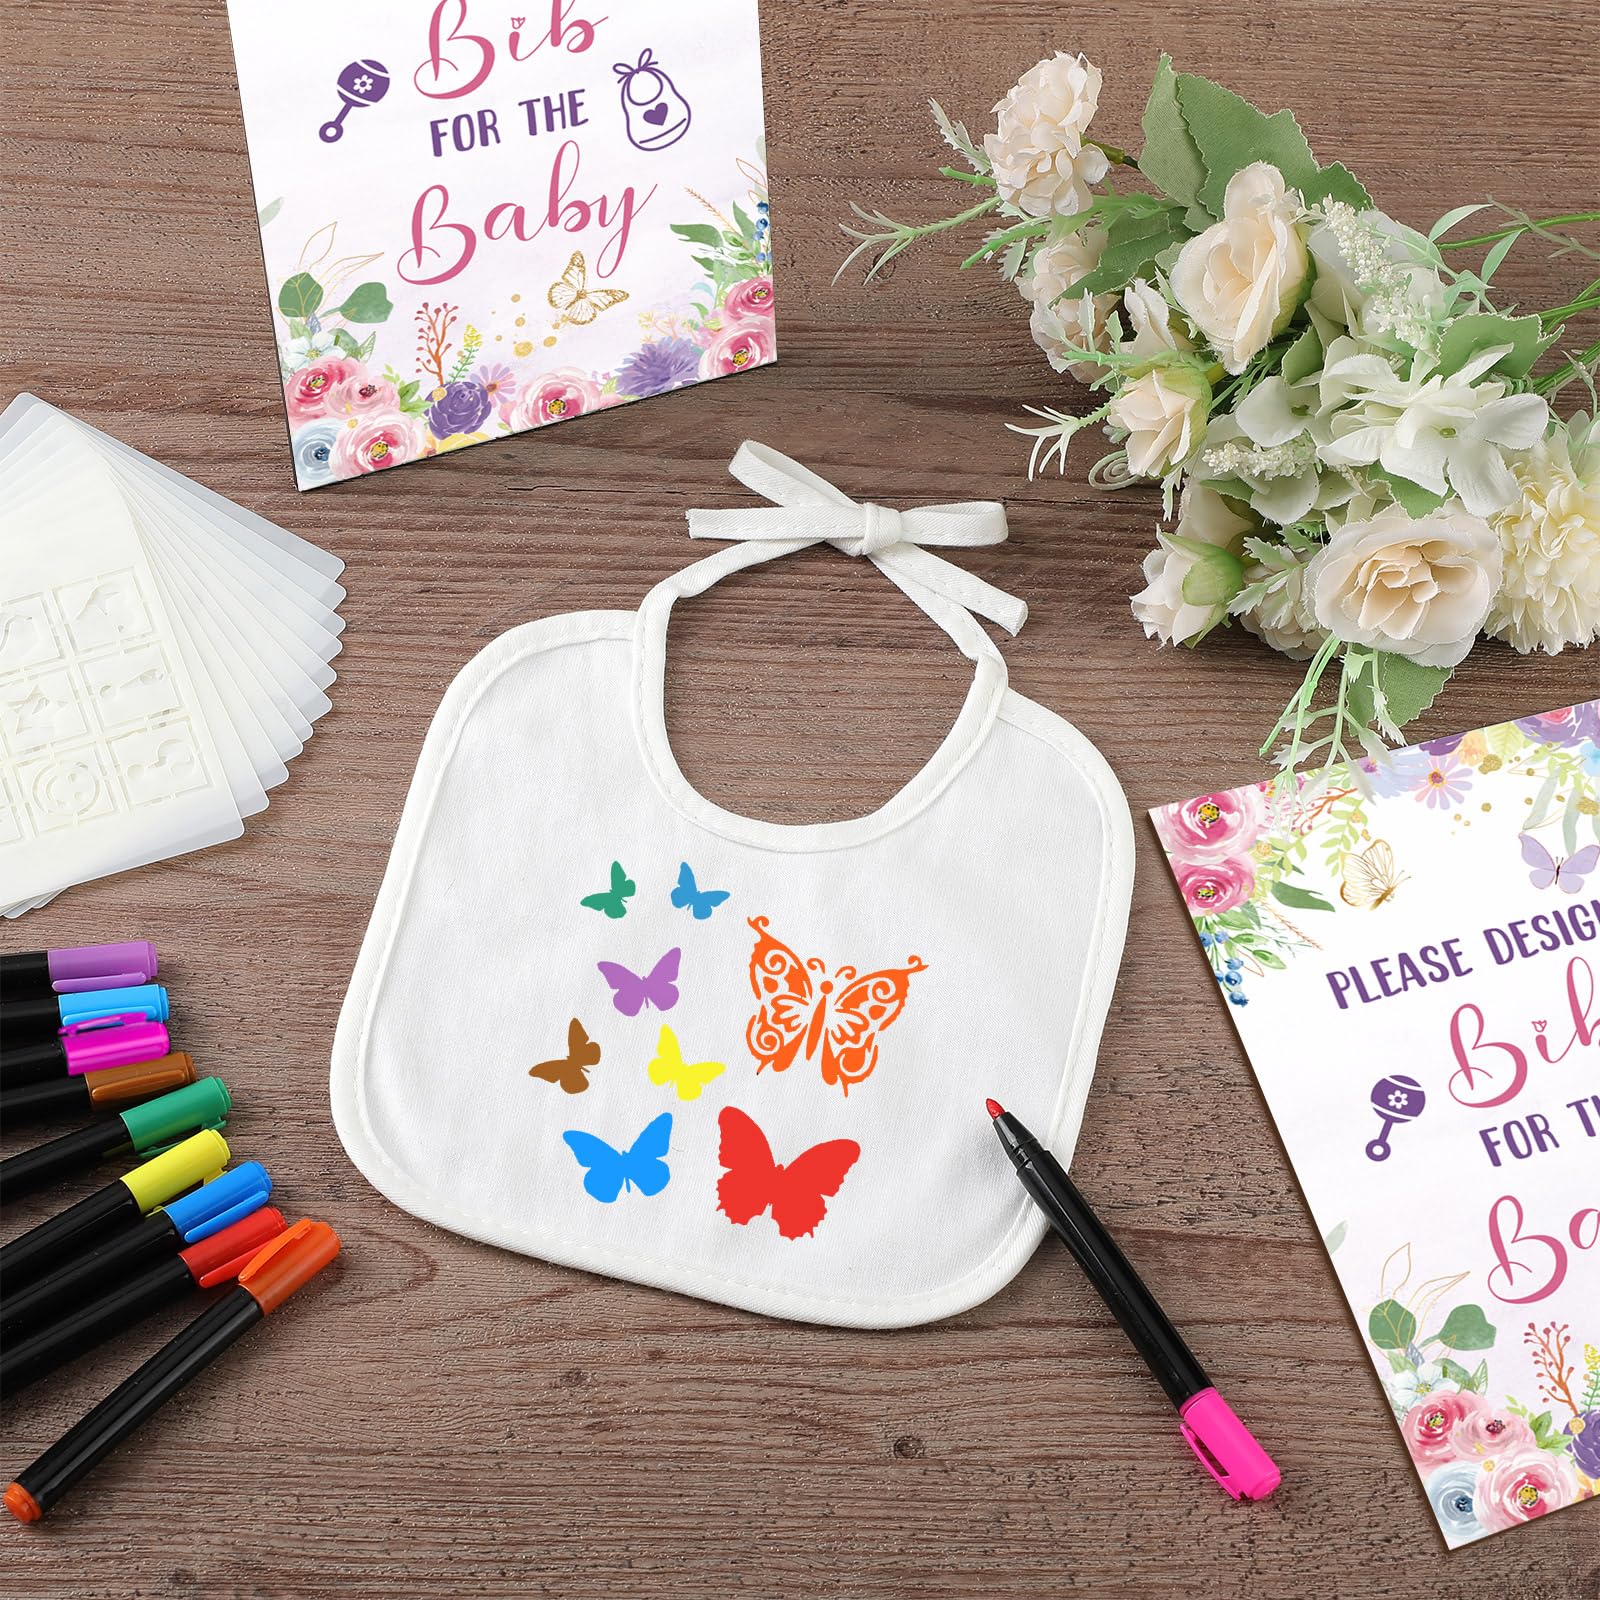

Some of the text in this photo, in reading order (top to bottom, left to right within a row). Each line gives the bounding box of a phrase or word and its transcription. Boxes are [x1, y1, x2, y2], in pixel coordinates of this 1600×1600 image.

[414, 0, 608, 99] Bib
[430, 89, 589, 157] FOR THE
[397, 140, 658, 285] Baby
[1325, 937, 1473, 1010] PLEASE
[1479, 1095, 1600, 1168] FOR T
